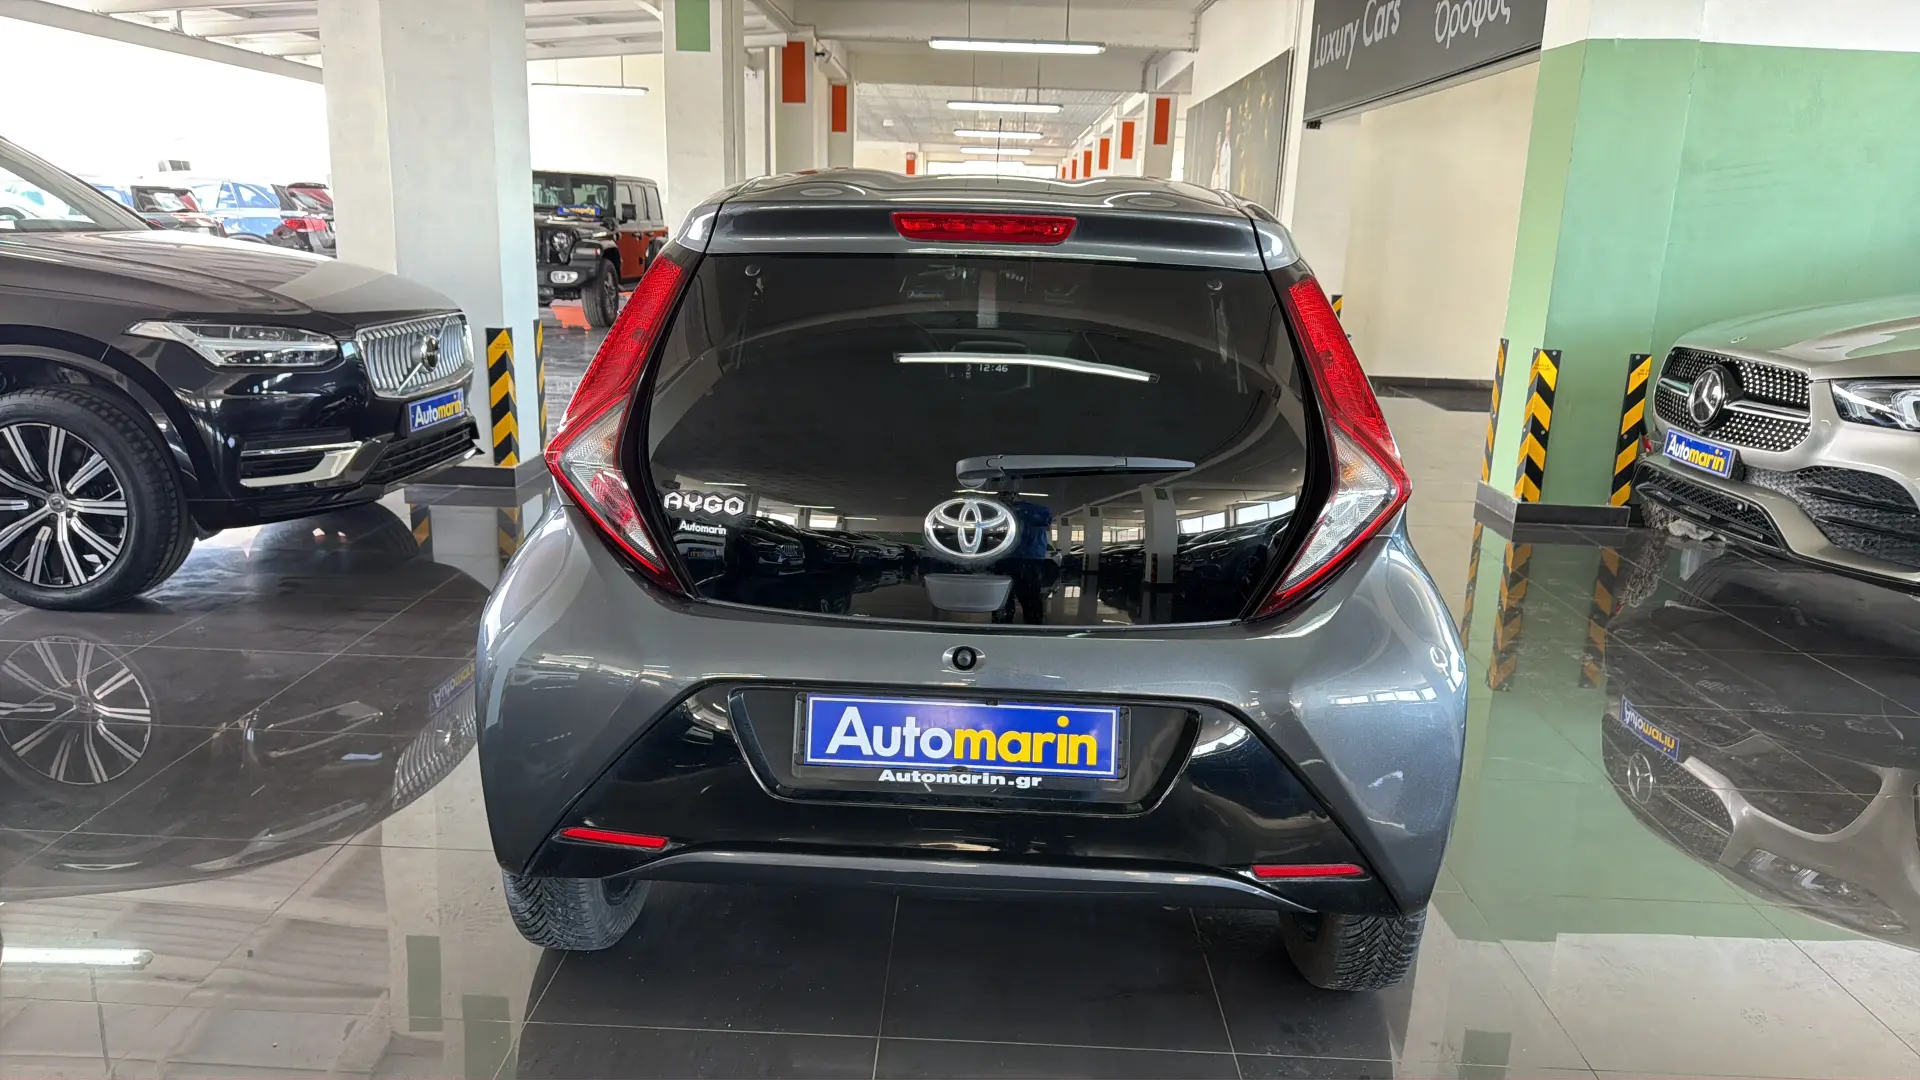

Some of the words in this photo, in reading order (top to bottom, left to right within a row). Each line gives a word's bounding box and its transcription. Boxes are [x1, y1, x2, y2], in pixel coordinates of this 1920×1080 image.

[1313, 18, 1360, 70] Luxury
[1362, 0, 1401, 47] Cars
[979, 364, 1009, 373] 12:46
[1666, 433, 1725, 472] Automarin
[663, 491, 745, 516] AYGO
[679, 520, 727, 535] Automarin
[825, 706, 1098, 766] Automarin
[878, 769, 1042, 788] Automarin.gr
